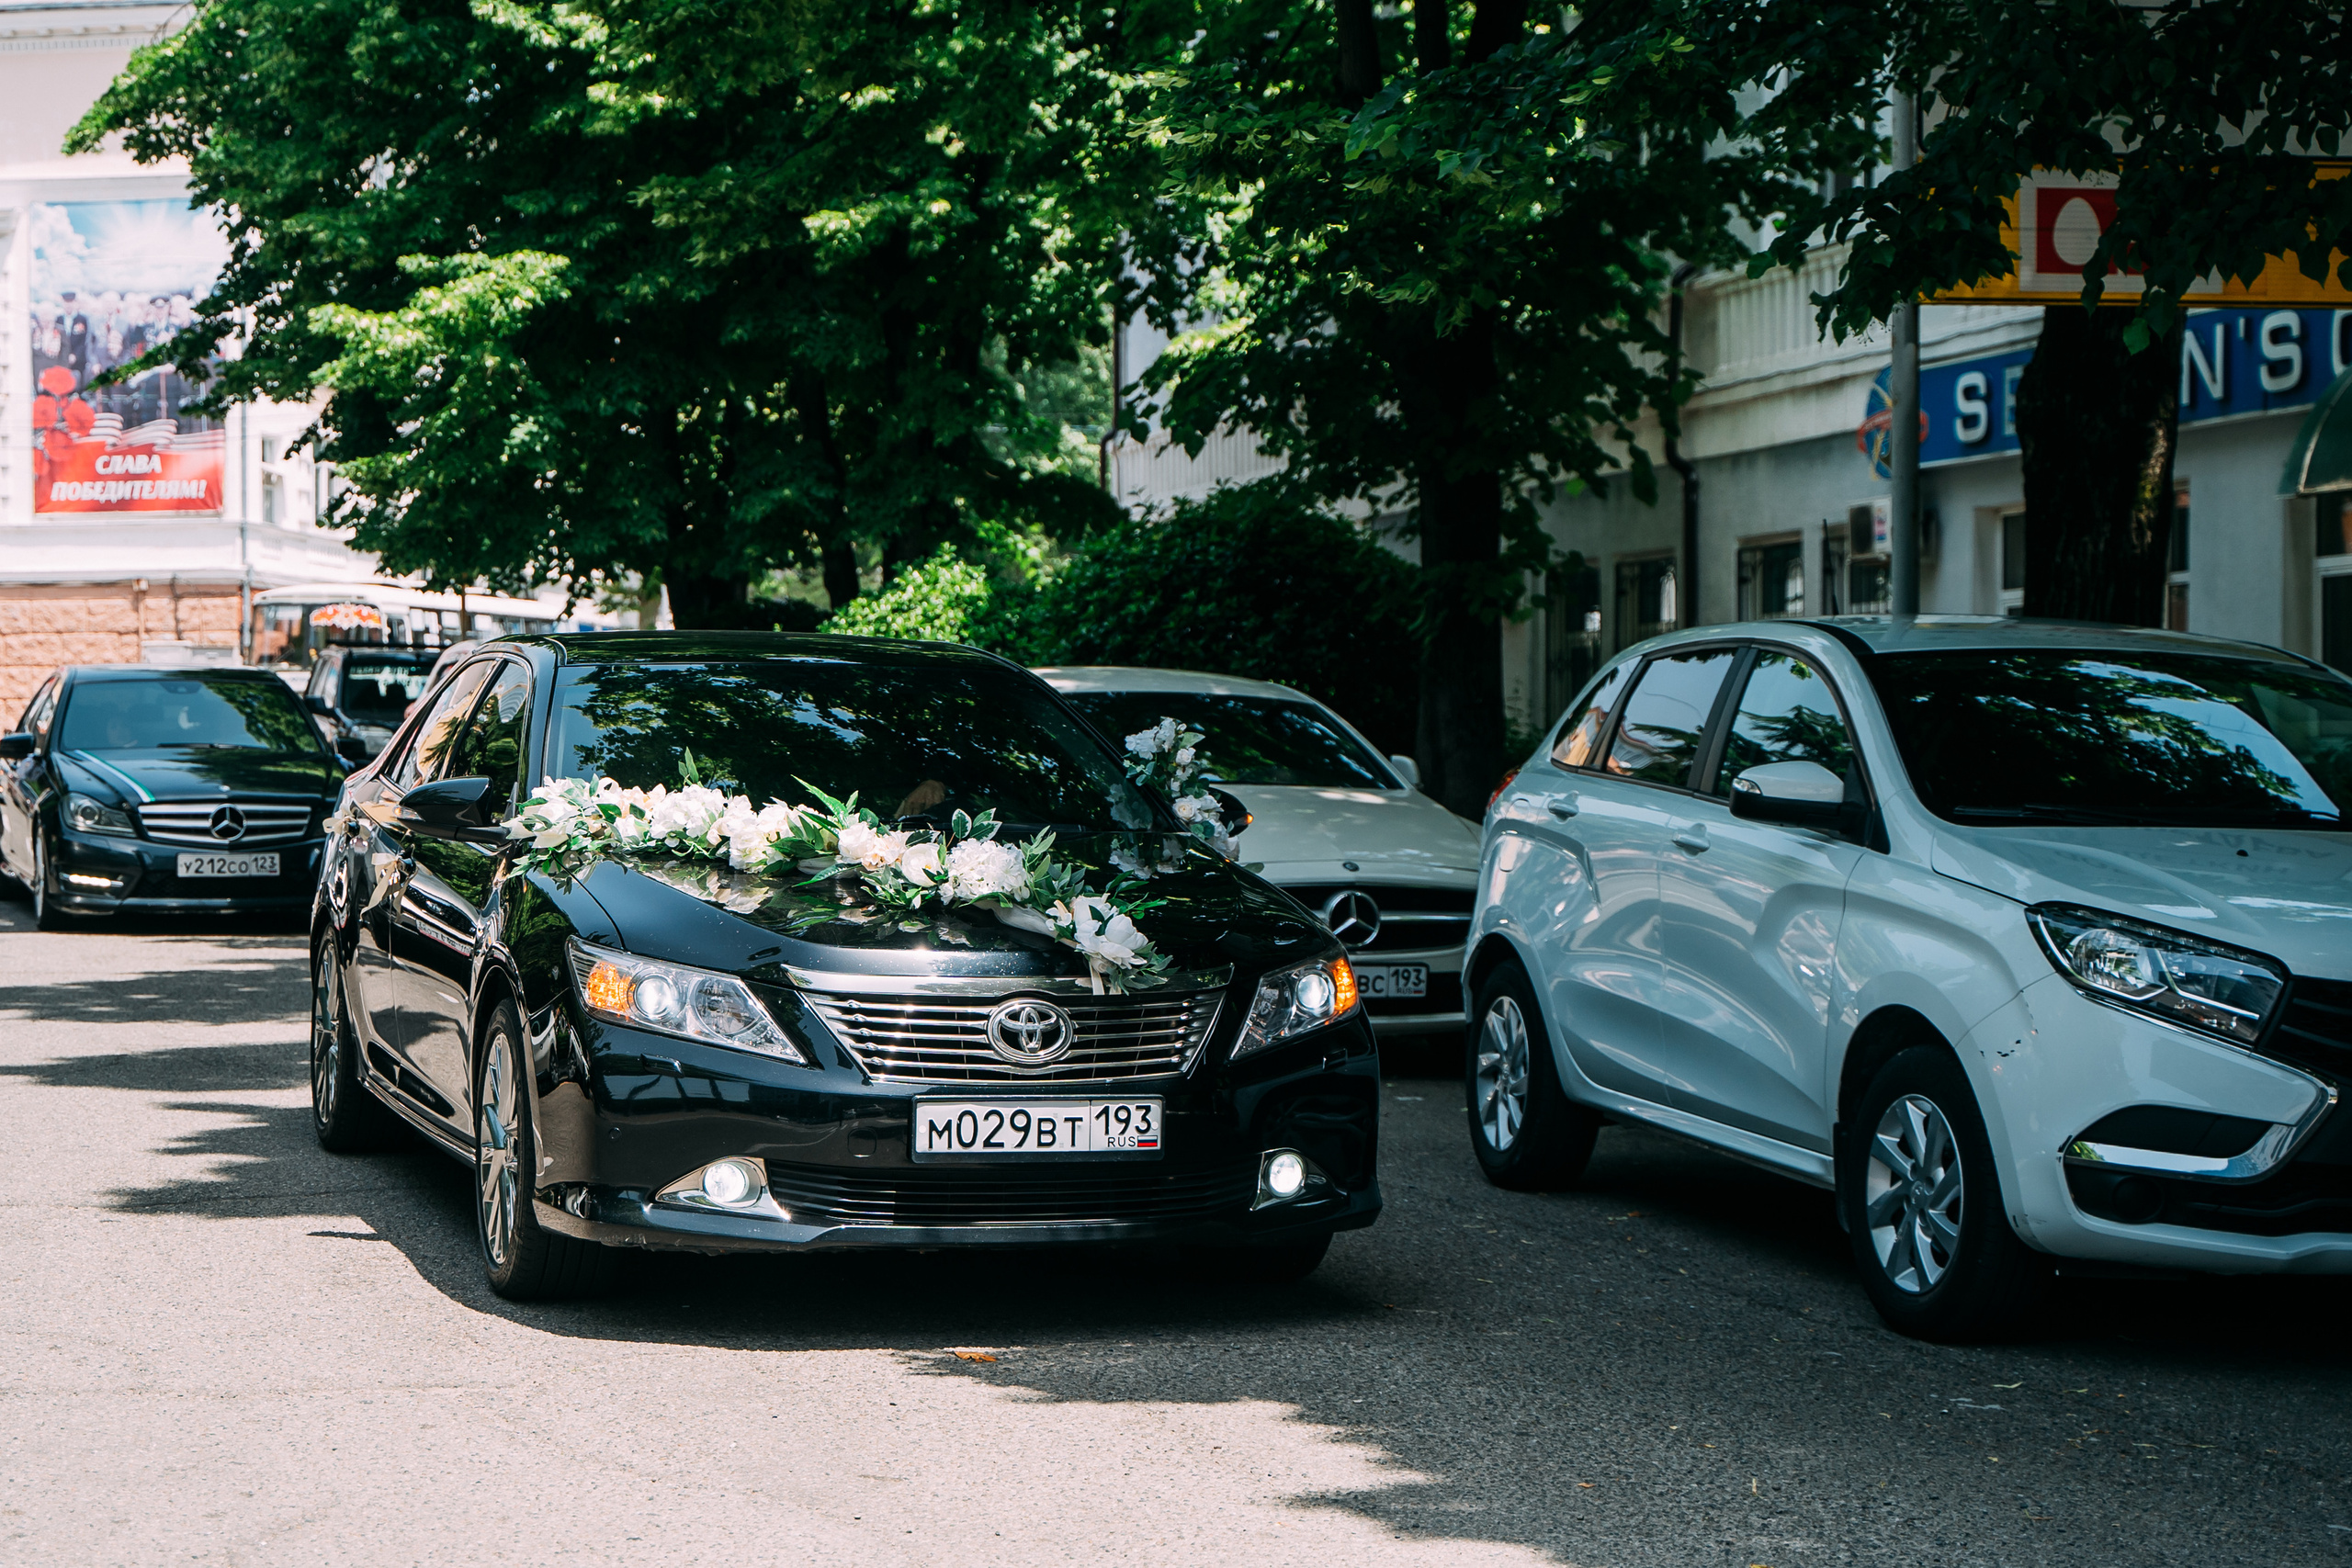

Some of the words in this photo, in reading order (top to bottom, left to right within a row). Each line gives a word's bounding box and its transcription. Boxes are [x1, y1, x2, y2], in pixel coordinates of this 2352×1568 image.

[95, 454, 163, 475] СЛАВА
[51, 479, 208, 504] ПОБЕДИТЕЛЯМ!
[251, 855, 277, 869] 123
[1391, 968, 1423, 987] 193
[928, 1109, 1083, 1150] М029ВТ
[1094, 1105, 1152, 1135] 193
[1107, 1137, 1136, 1147] RUS
